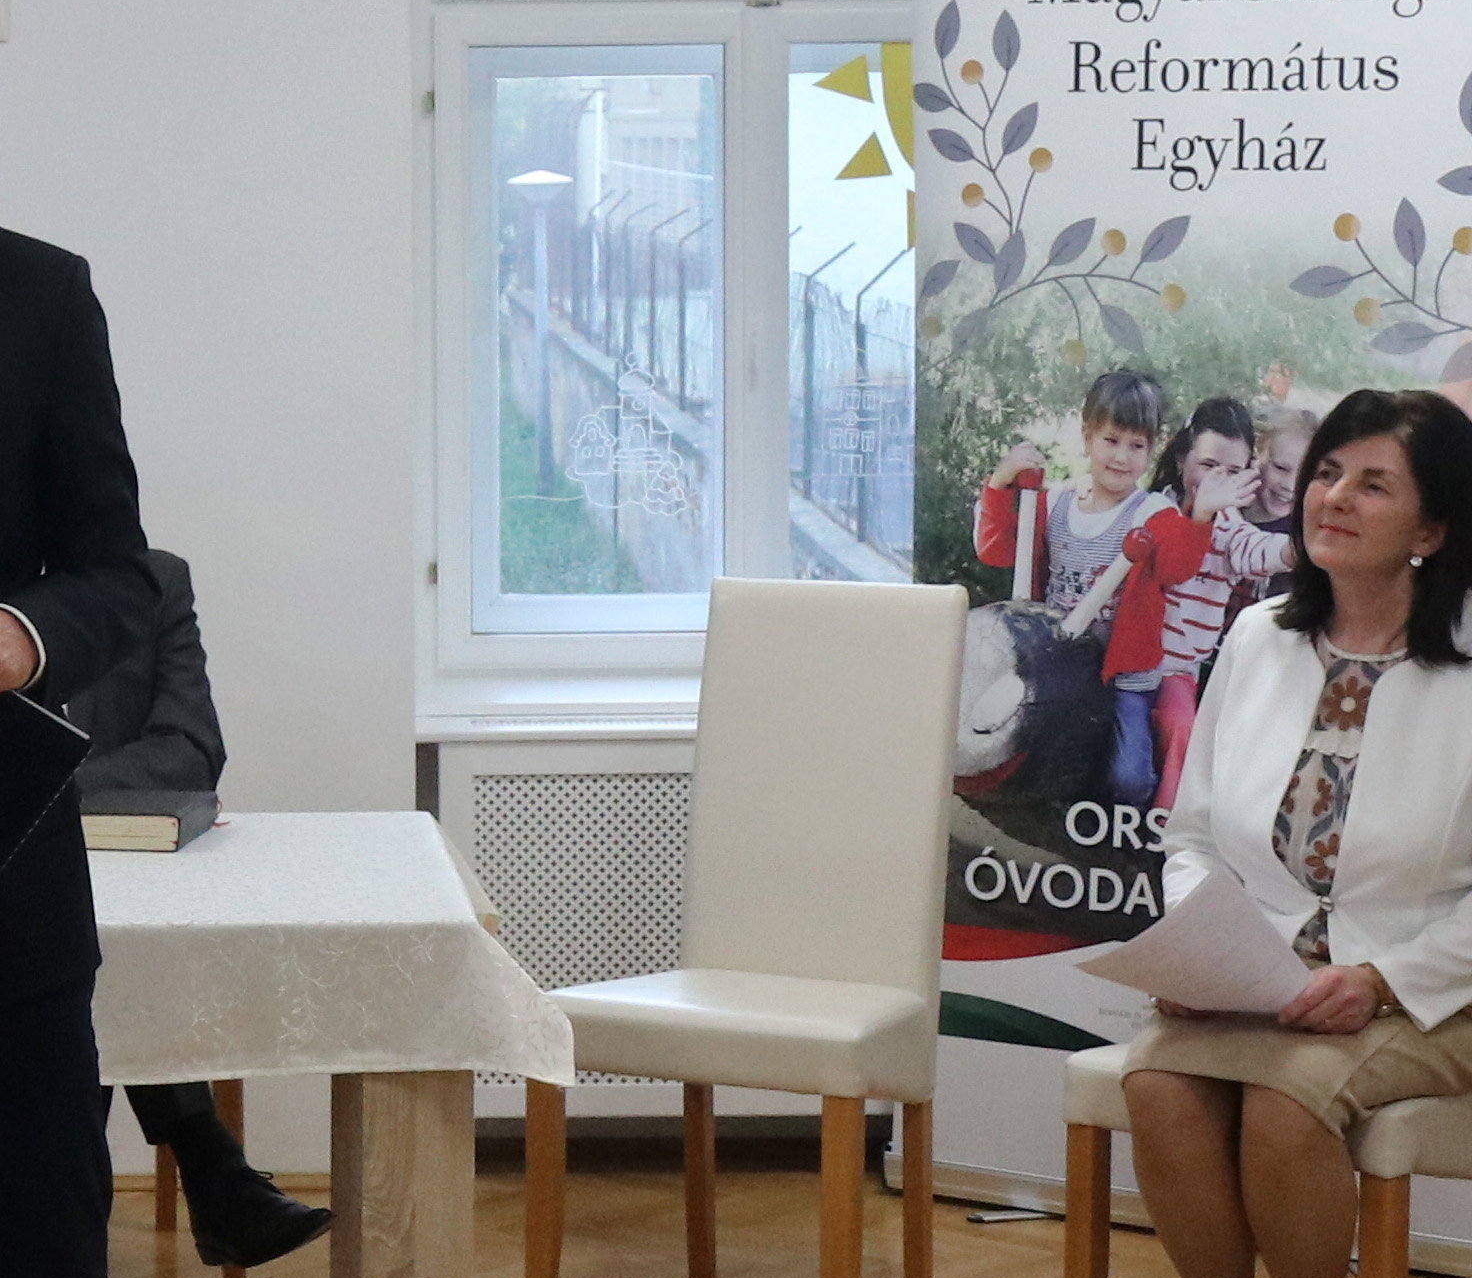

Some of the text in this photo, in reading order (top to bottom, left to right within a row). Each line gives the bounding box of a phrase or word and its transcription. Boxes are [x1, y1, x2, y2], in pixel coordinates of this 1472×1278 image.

[1068, 39, 1399, 93] Református
[1131, 118, 1327, 191] Egyház
[1065, 800, 1169, 853] ORS
[964, 846, 1159, 917] ÓVODA
